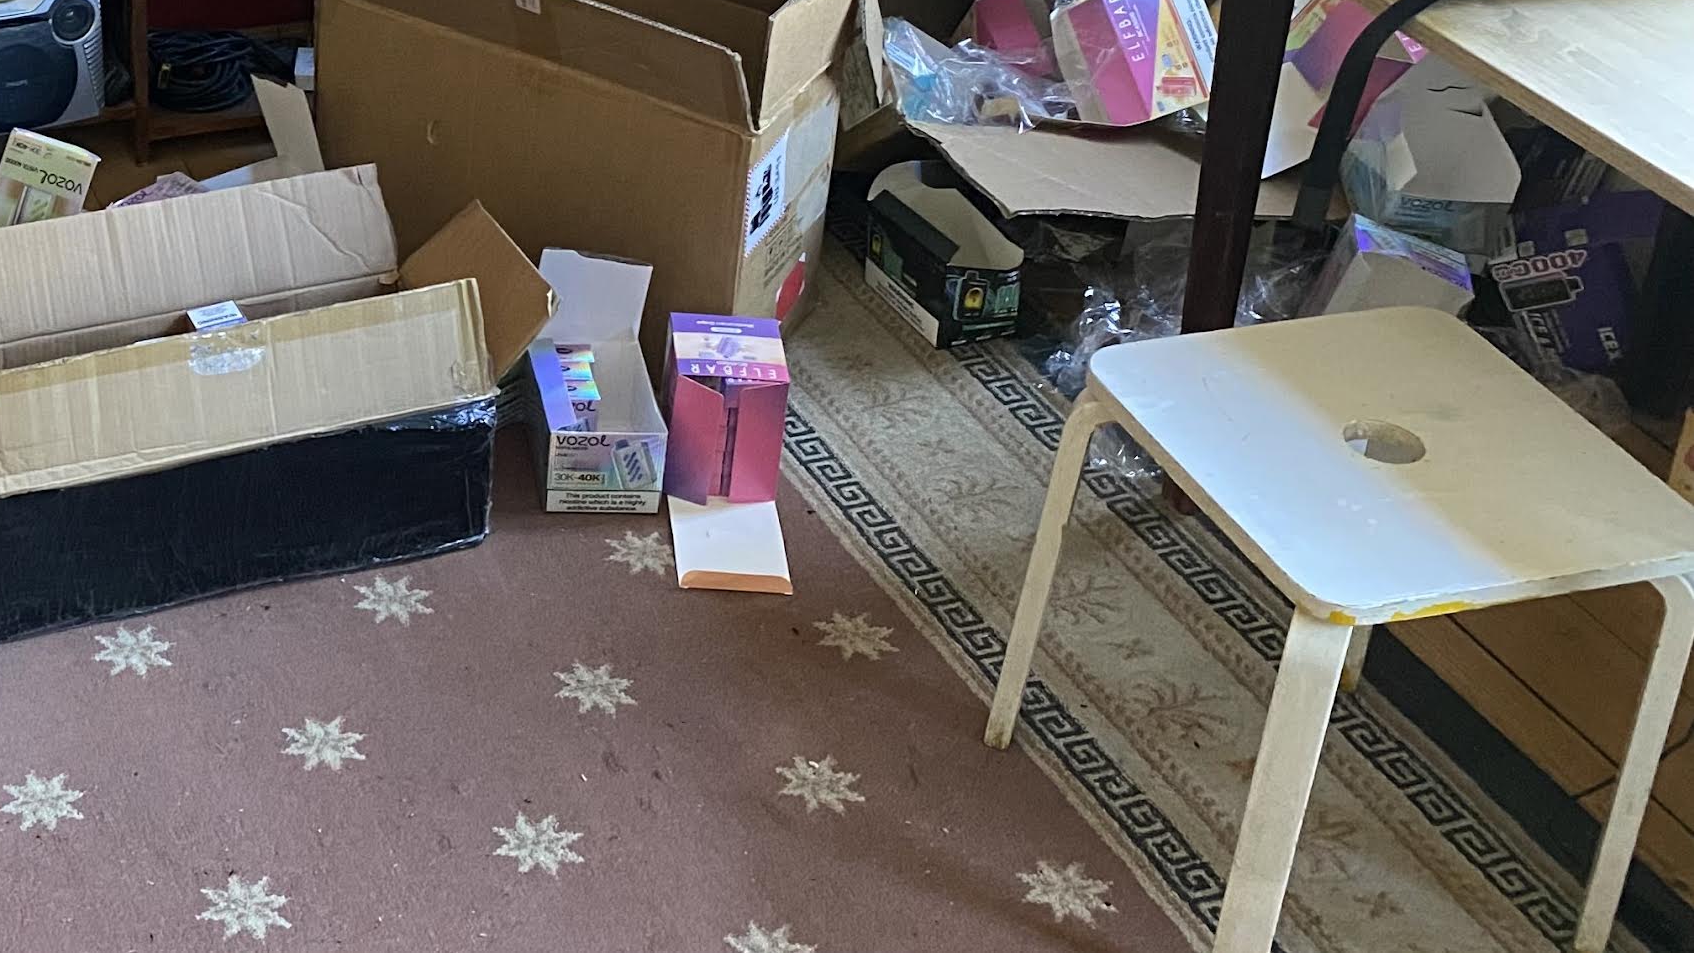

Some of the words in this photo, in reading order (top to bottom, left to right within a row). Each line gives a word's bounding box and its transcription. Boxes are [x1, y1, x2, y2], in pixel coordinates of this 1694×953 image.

[39, 169, 83, 195] VOZOL
[690, 363, 777, 379] ELFBAR
[556, 434, 610, 447] VOZOL
